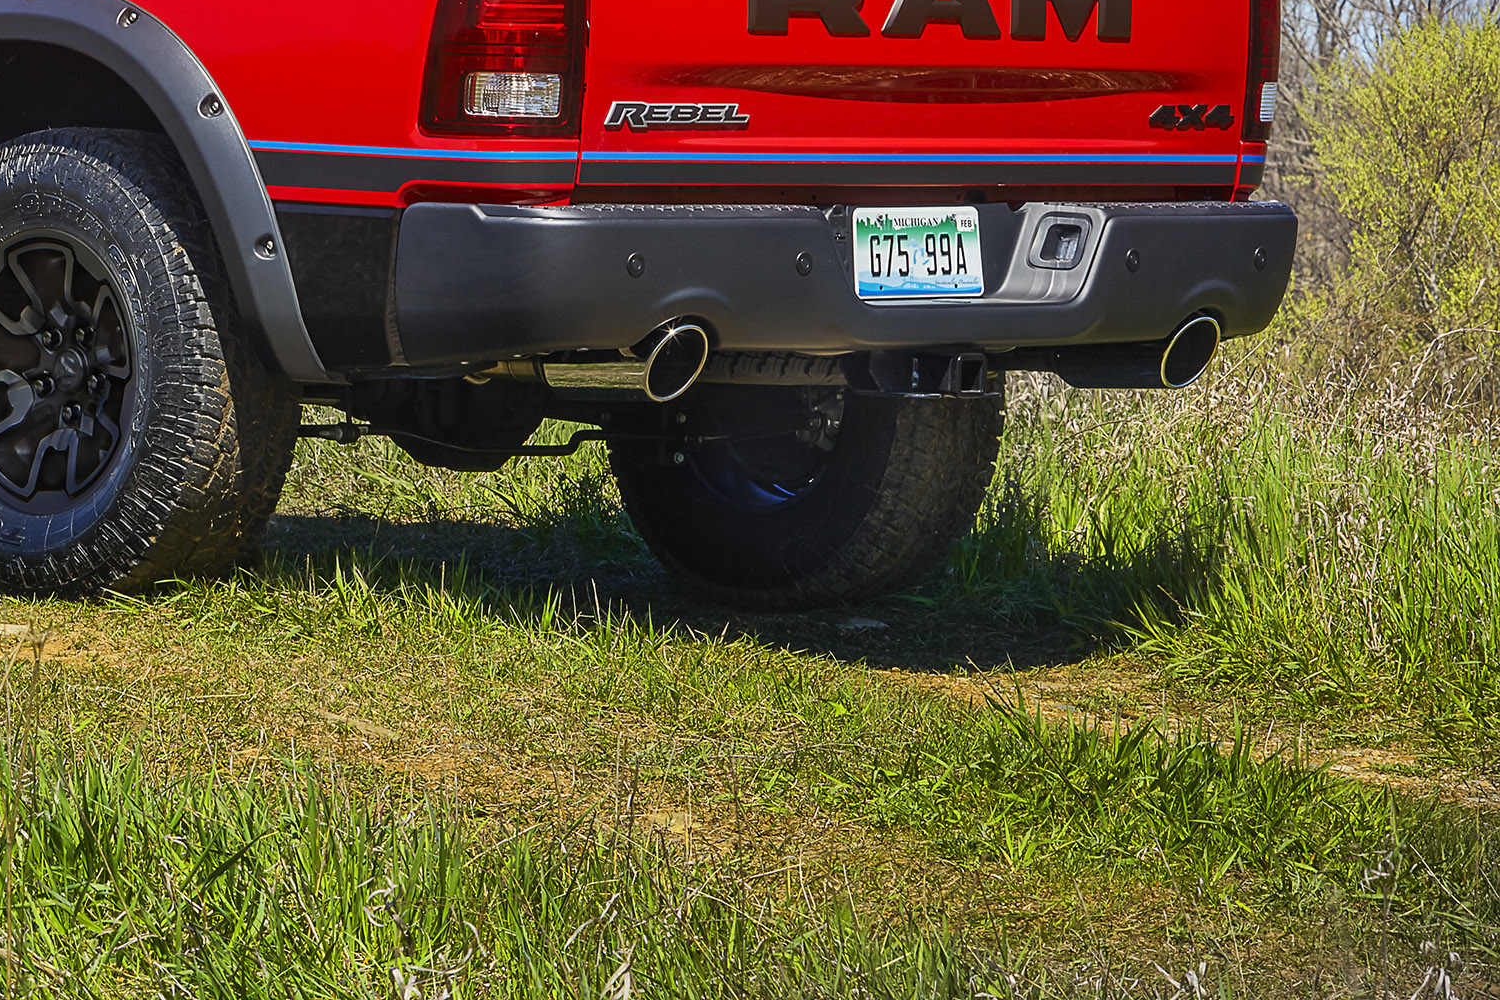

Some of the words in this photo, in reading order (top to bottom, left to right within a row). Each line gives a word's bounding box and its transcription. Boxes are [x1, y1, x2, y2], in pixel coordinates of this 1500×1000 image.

[604, 101, 750, 131] REBEL
[893, 216, 939, 228] MICHIGAN
[960, 218, 973, 229] FEB
[925, 233, 968, 276] 99A
